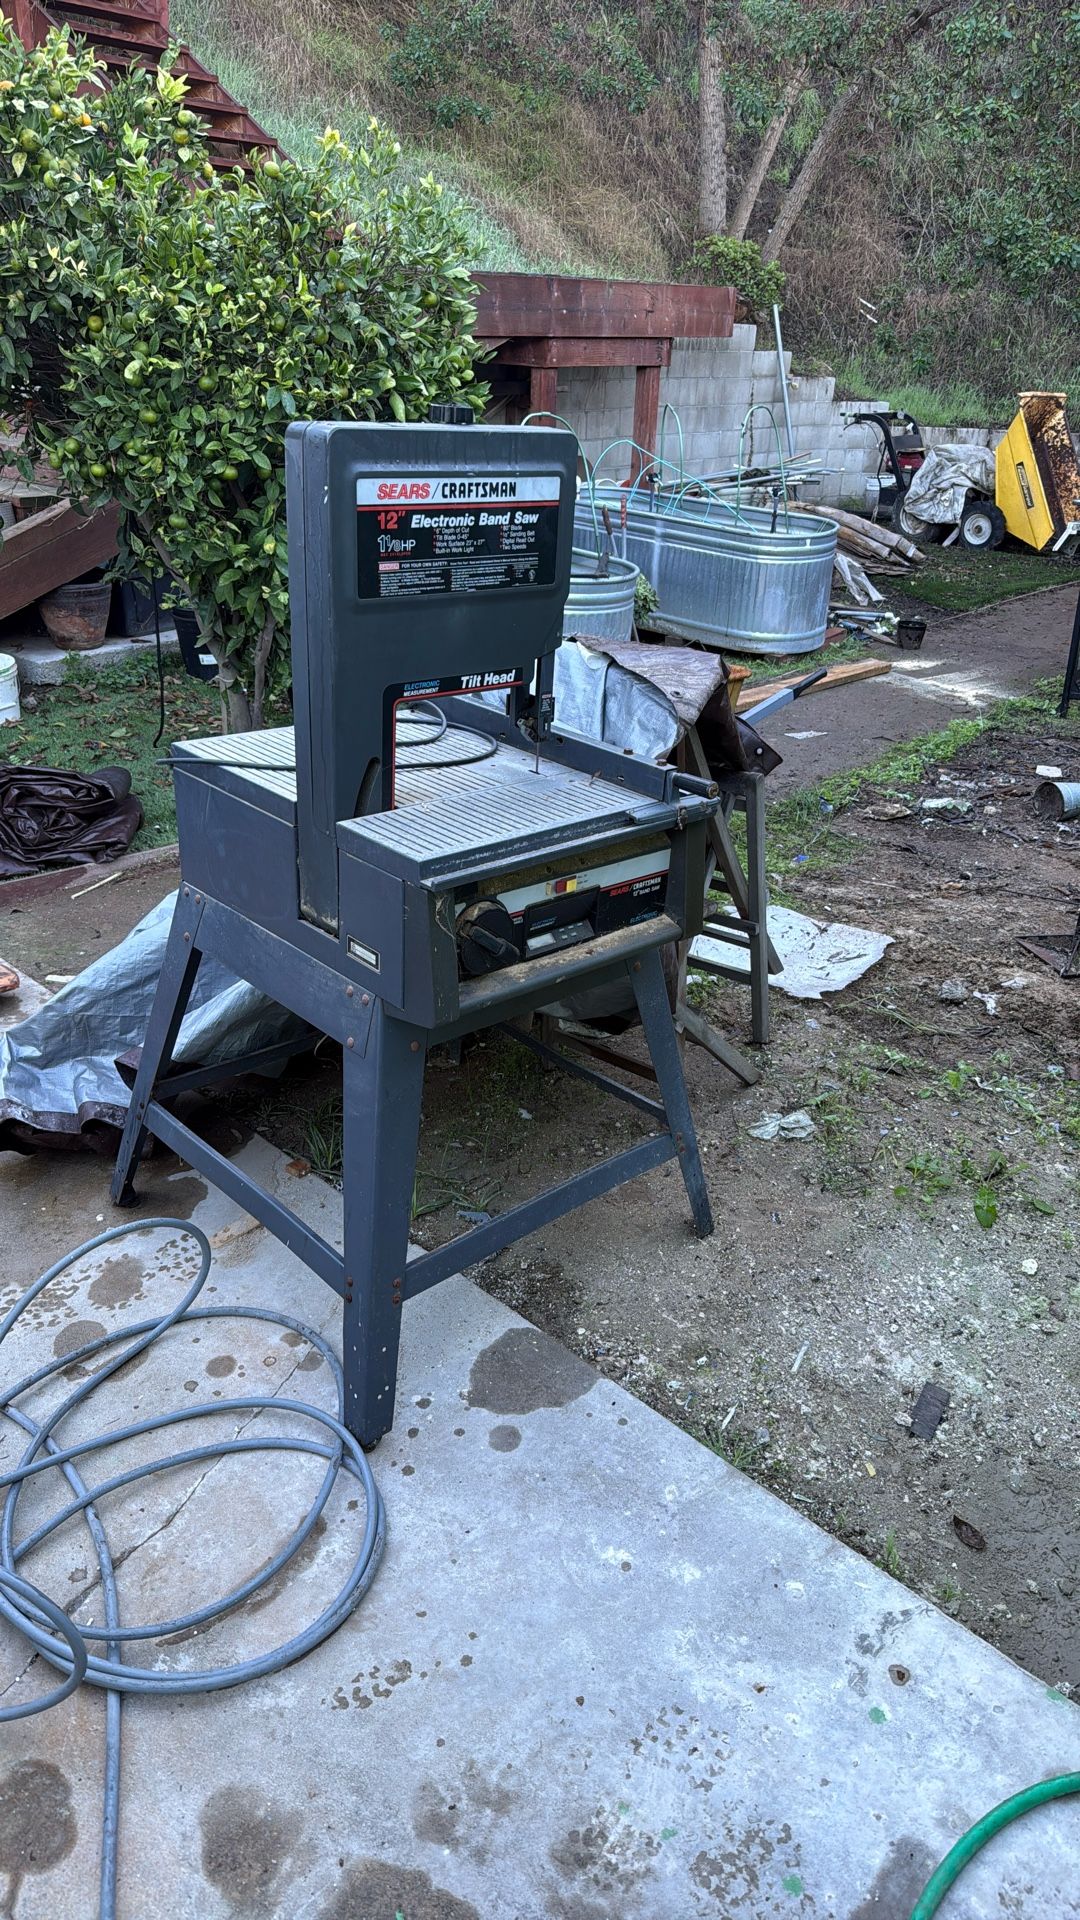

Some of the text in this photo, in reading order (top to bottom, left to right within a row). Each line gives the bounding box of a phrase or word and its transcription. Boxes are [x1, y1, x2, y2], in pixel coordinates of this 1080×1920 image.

[378, 510, 539, 530] 12" Electronic Band Saw
[441, 527, 455, 535] Depth
[460, 526, 470, 534] Cut
[448, 540, 465, 548] Surface
[502, 537, 515, 545] Digital
[463, 546, 475, 554] Light
[460, 669, 516, 689] Tilt Head
[404, 679, 441, 691] ELECTRONIC
[403, 686, 439, 697] MEASUREMENT
[639, 887, 651, 895] BAND
